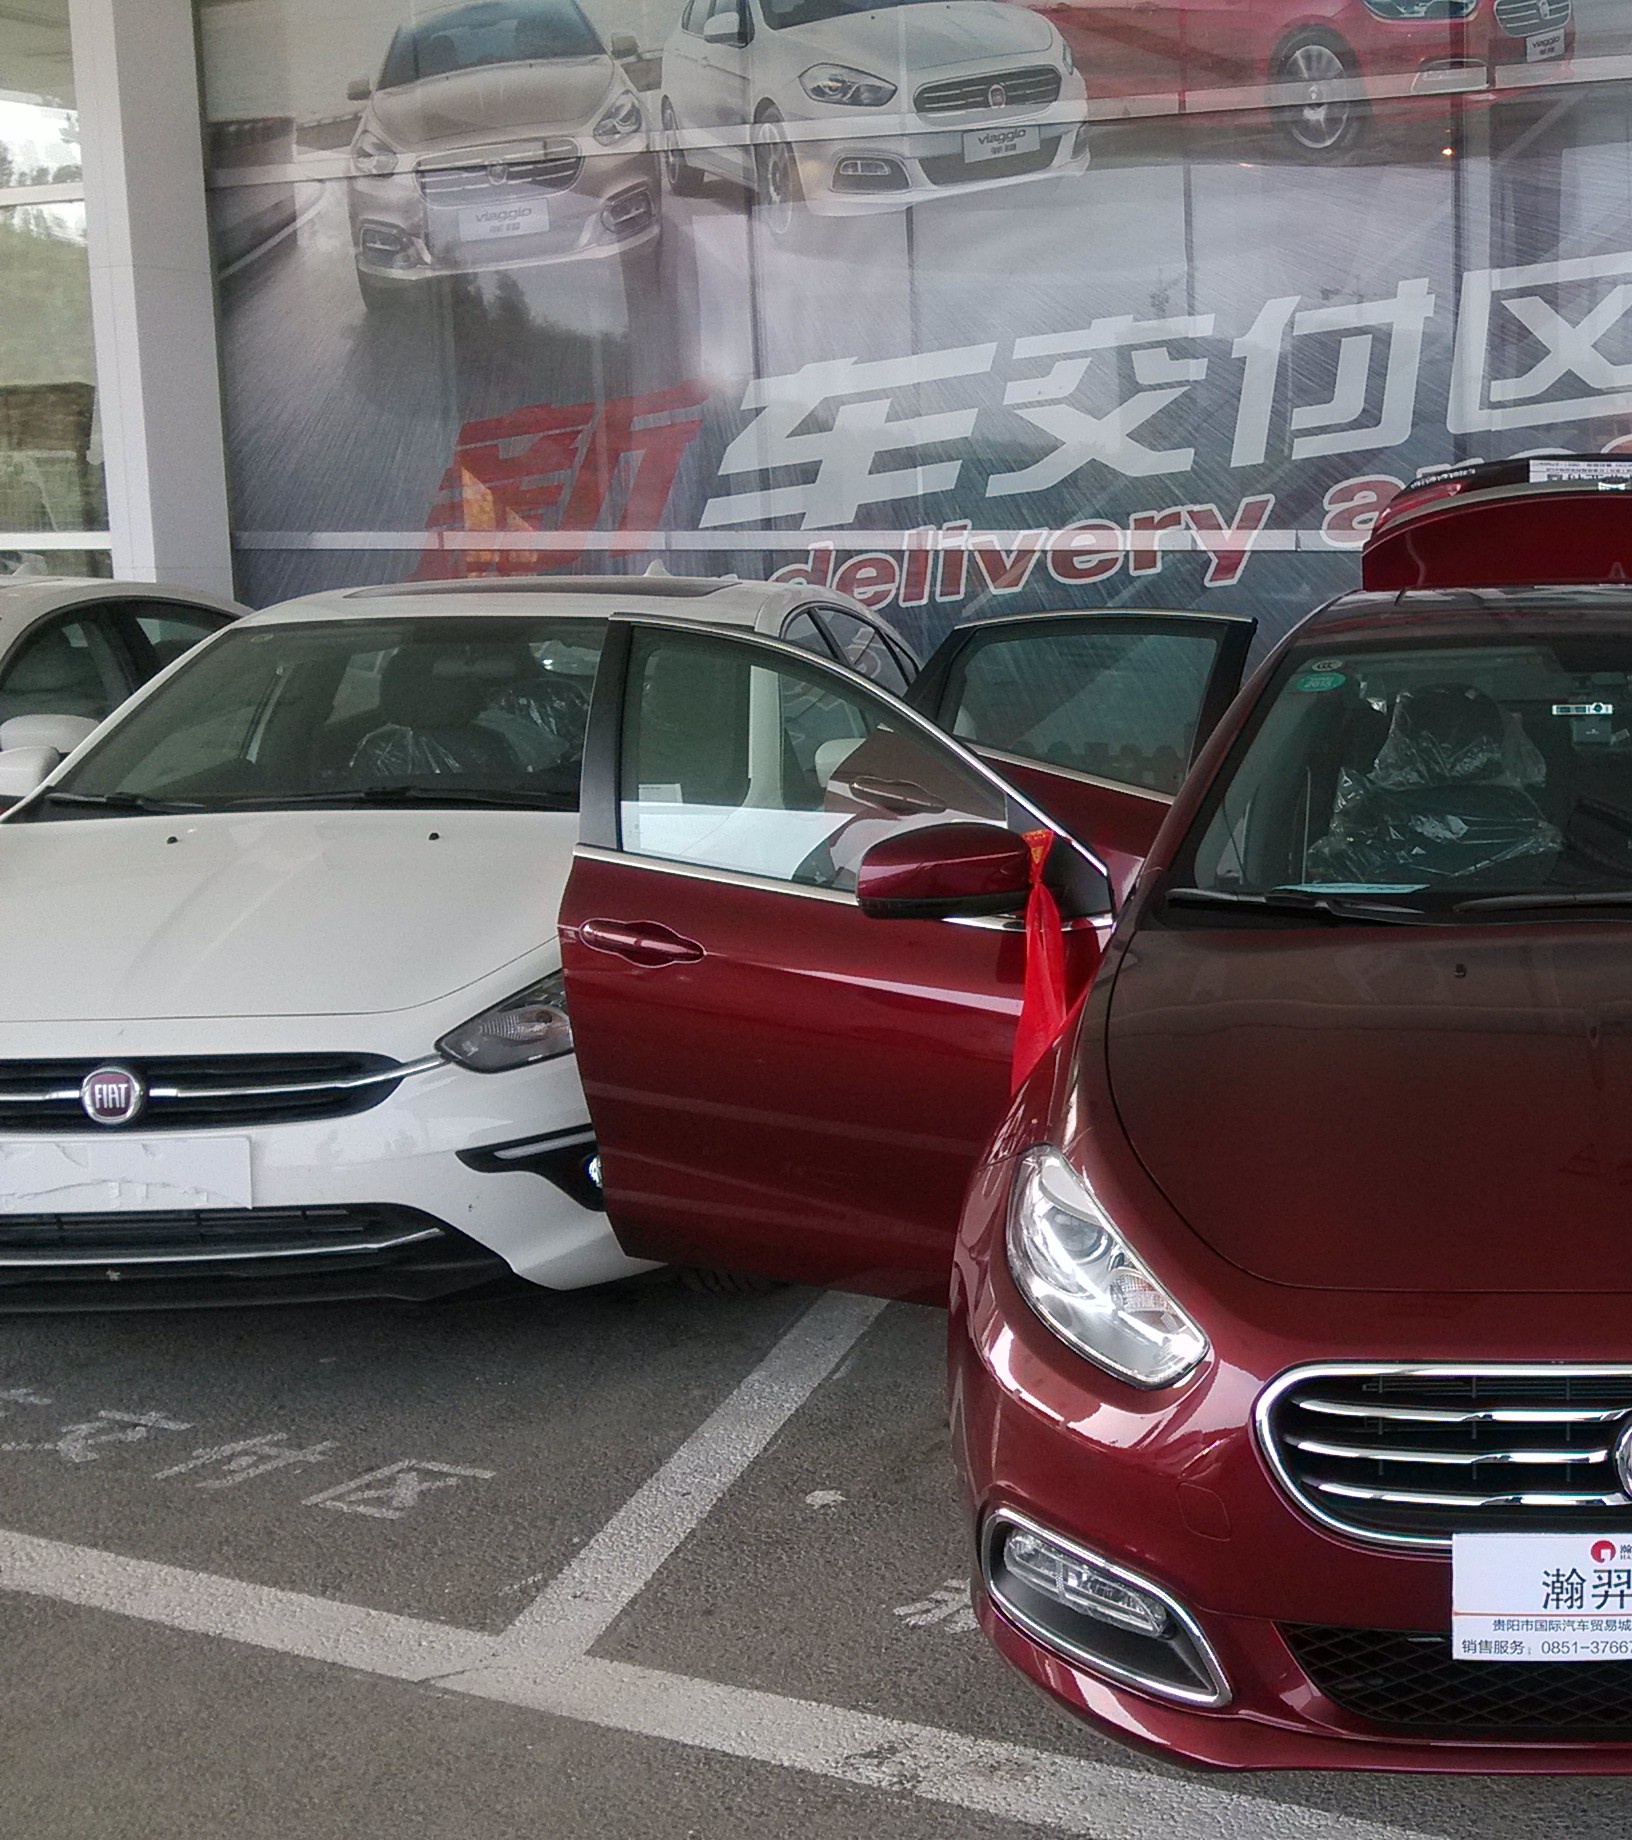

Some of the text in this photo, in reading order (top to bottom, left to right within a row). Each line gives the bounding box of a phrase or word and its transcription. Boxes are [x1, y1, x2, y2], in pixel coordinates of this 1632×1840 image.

[978, 128, 1026, 144] viaggio
[772, 494, 1273, 611] delivery
[94, 1083, 128, 1109] FIAT
